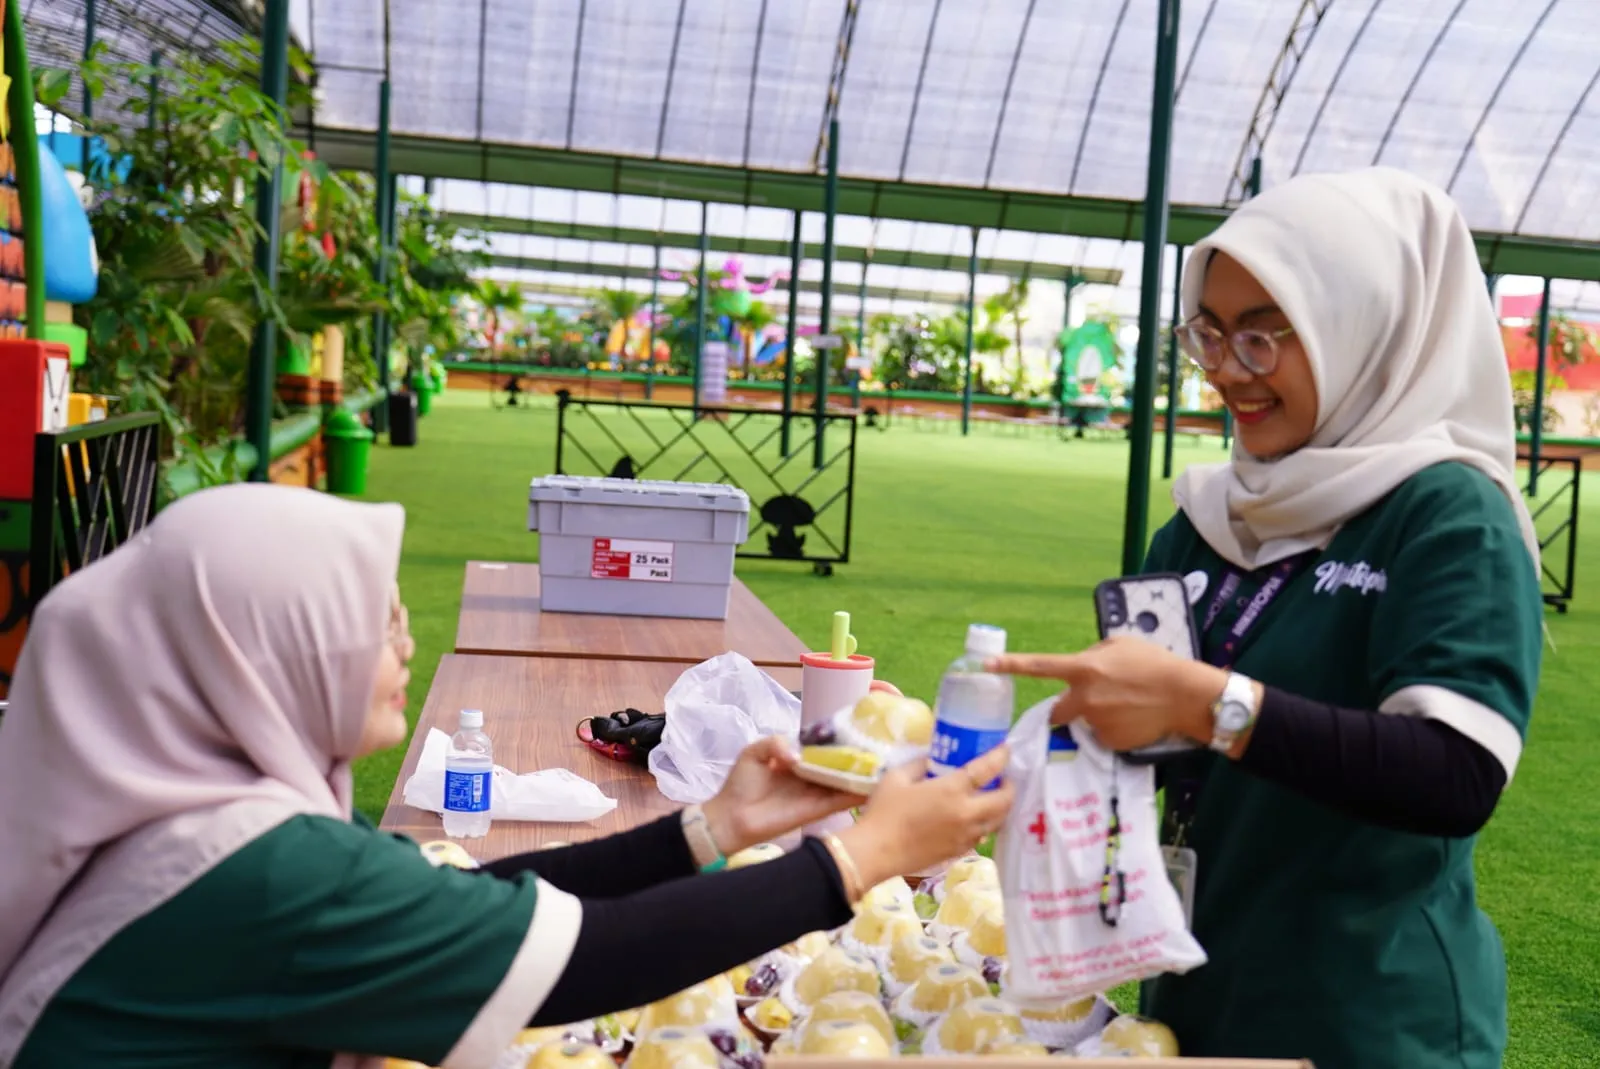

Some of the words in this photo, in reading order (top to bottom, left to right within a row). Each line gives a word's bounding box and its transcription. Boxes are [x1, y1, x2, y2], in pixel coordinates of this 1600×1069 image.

[636, 554, 647, 564] 25
[651, 556, 669, 564] Pack
[650, 569, 669, 577] Pack
